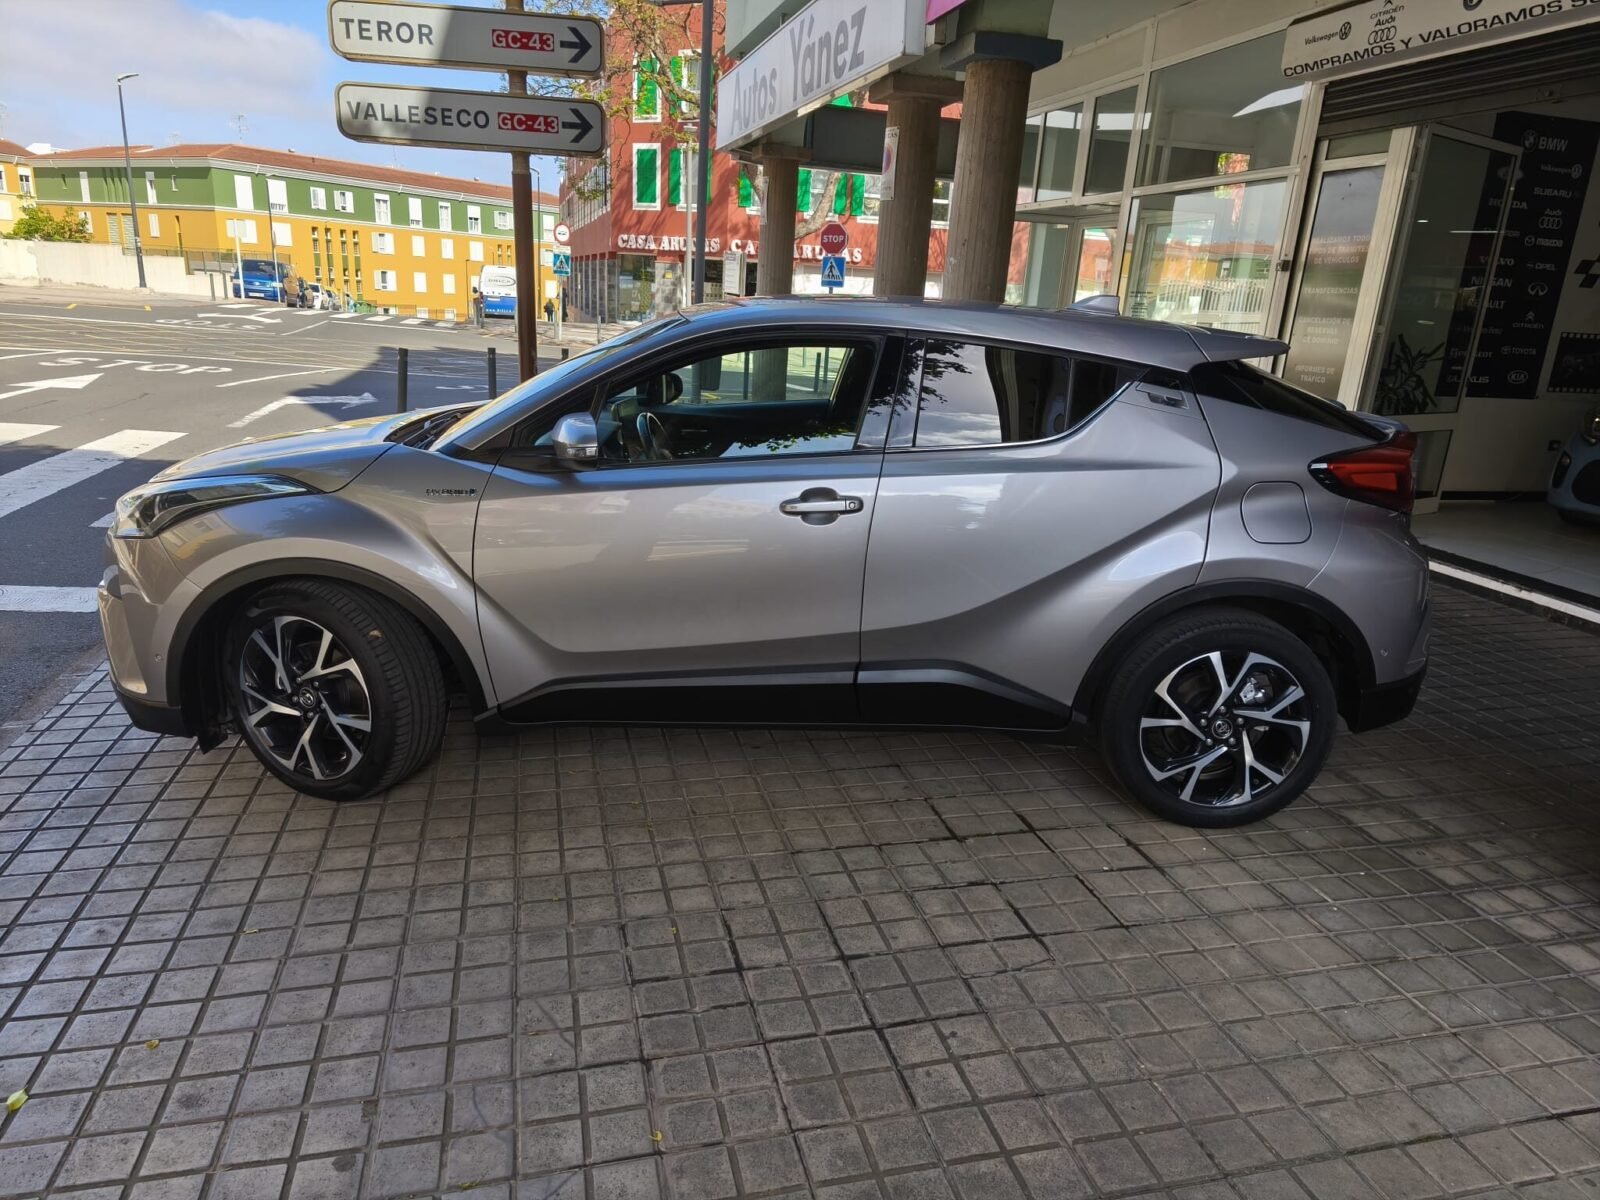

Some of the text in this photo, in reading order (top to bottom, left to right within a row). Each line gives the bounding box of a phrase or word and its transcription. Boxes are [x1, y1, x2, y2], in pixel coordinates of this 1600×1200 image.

[1374, 15, 1396, 28] Audi
[338, 17, 555, 51] TEROR GC-43
[1283, 42, 1395, 78] COMPRAMOS
[1400, 37, 1413, 49] Y
[1418, 0, 1562, 43] VALORAMOS
[1304, 31, 1339, 46] Volkswagen
[731, 6, 868, 136] Autos Yánez
[346, 100, 560, 134] VALLESECO GC-43
[1538, 136, 1569, 152] BMW
[1533, 187, 1572, 198] SUBARU
[617, 234, 657, 250] CASA
[822, 235, 844, 243] STOP
[39, 357, 233, 375] STOP
